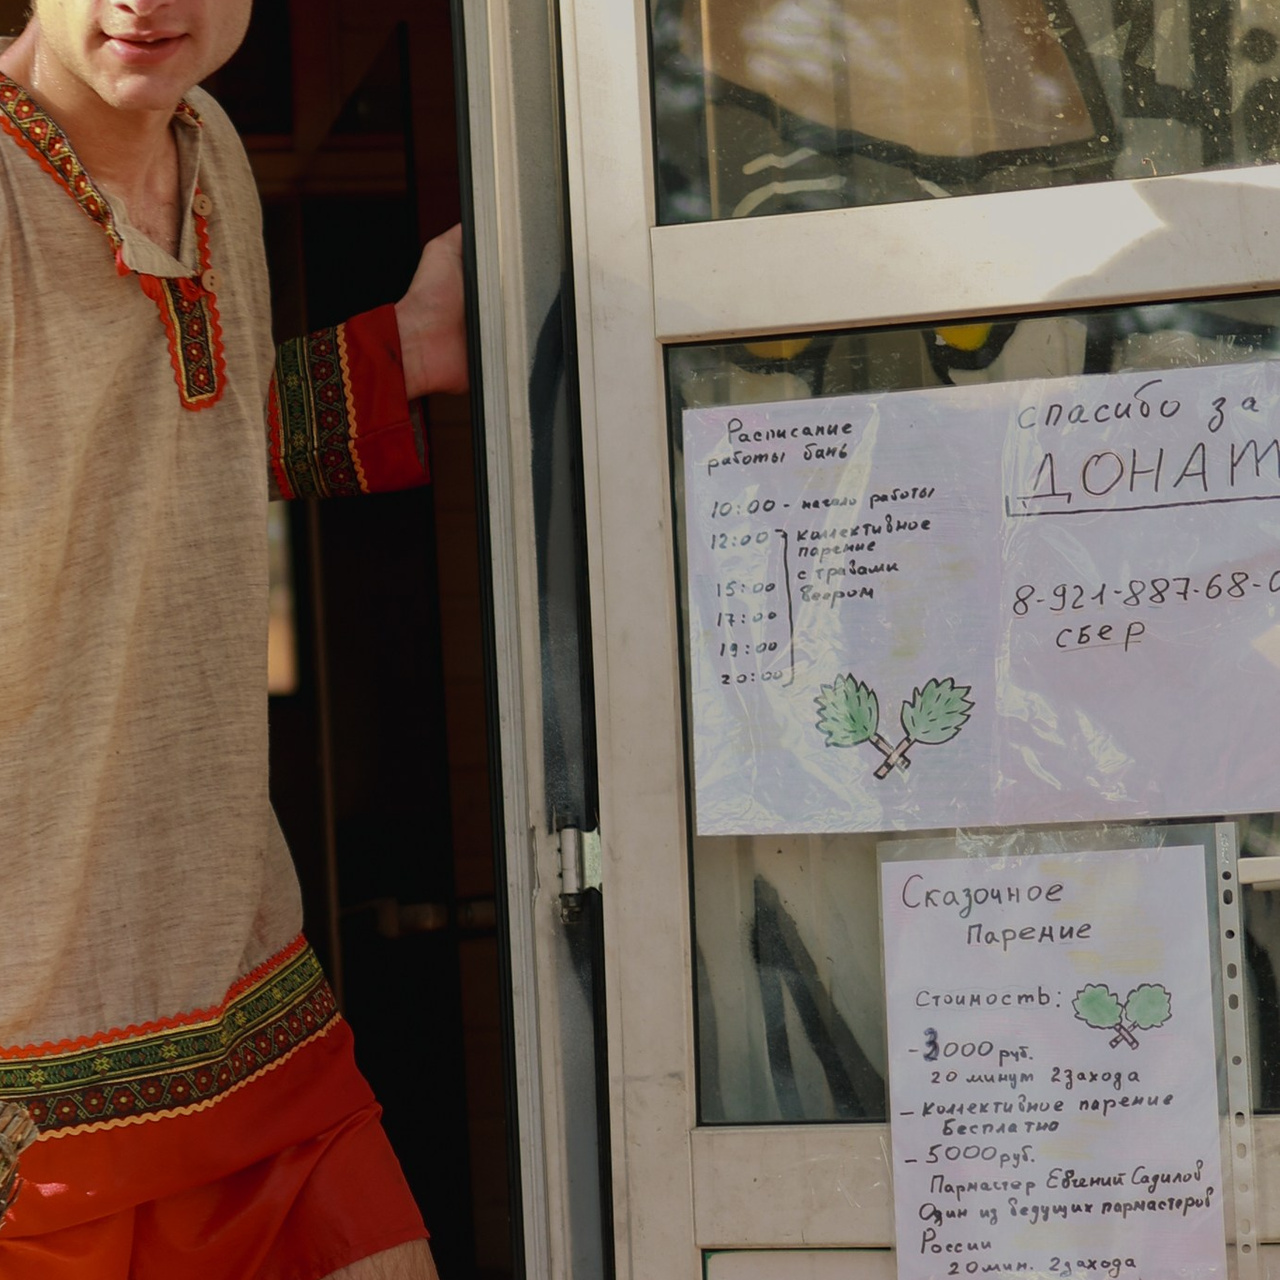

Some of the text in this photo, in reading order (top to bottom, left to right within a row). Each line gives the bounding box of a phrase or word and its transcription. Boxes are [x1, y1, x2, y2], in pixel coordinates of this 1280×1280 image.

[708, 443, 849, 476] работы бань
[711, 499, 776, 519] 10:00
[869, 487, 936, 509] работы
[710, 531, 769, 550] 12:00
[716, 582, 776, 598] 15:00
[717, 611, 777, 627] 17:00
[719, 641, 778, 657] 19:00
[720, 669, 784, 685] 20:00
[902, 874, 1063, 919] Сказочное
[967, 923, 1092, 951] Парение
[915, 985, 1062, 1008] Стоимость:
[930, 1070, 958, 1084] 20
[966, 1072, 1035, 1090] минут
[1079, 1093, 1174, 1117] парение
[930, 1174, 1036, 1202] Пармастер
[920, 1227, 992, 1254] России
